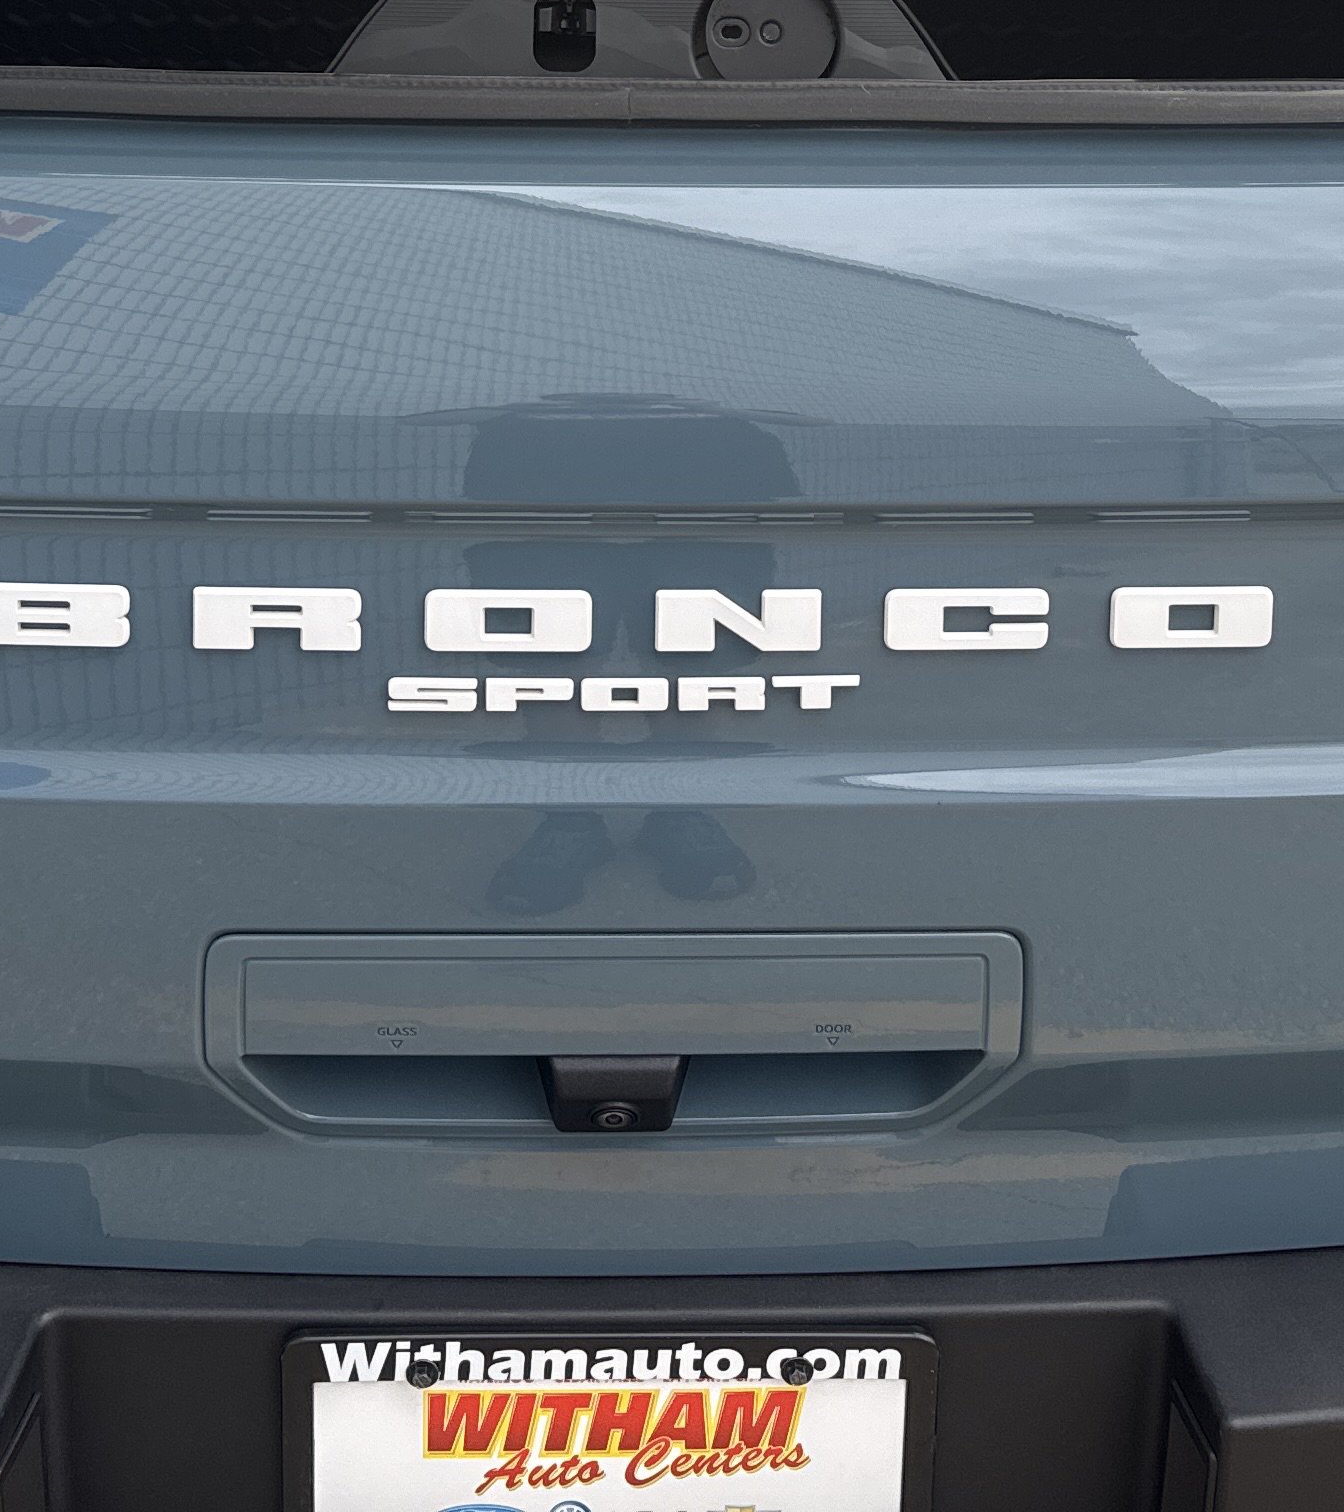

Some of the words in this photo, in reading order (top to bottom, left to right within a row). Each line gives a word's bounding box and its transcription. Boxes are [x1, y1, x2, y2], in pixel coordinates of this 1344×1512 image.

[388, 675, 860, 712] SPORT
[377, 1027, 417, 1036] GLASS
[815, 1024, 852, 1033] DOOR
[423, 1387, 806, 1456] WITHAM
[475, 1447, 605, 1495] Auto
[624, 1436, 811, 1488] Centers
